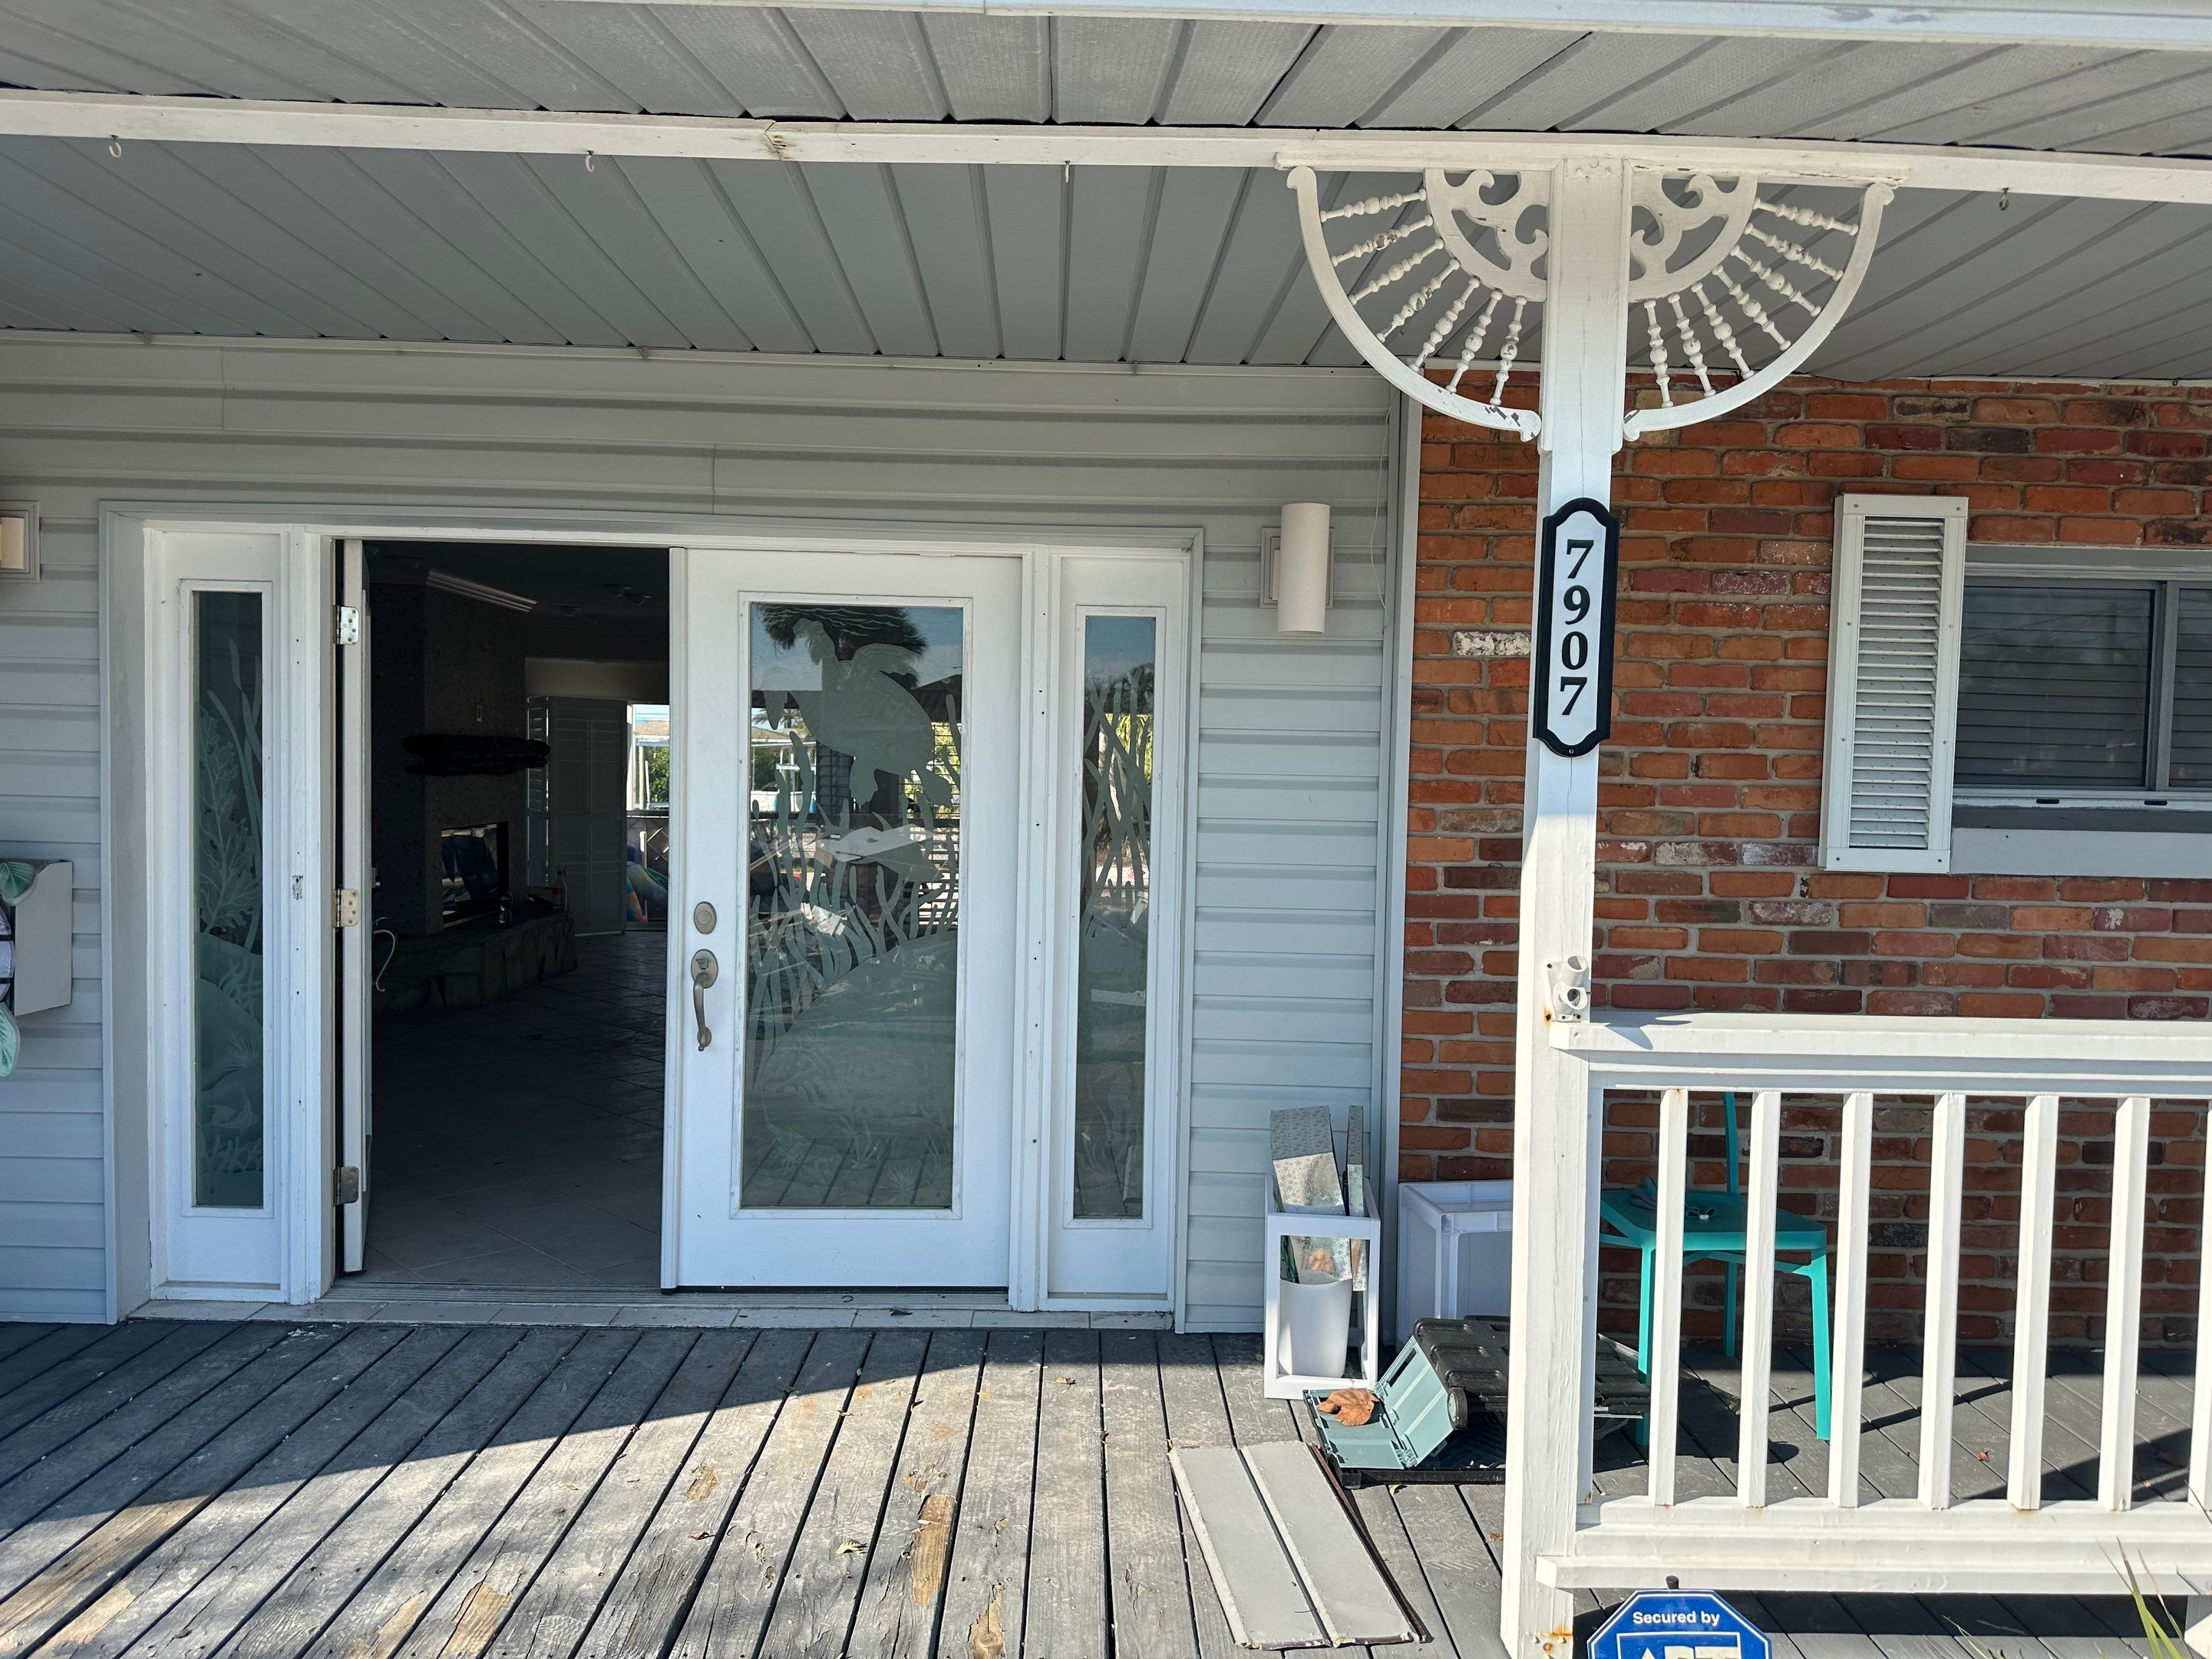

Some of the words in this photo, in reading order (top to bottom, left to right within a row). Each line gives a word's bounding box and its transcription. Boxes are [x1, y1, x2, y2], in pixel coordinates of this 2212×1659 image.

[1560, 539, 1594, 716] 7907
[1633, 1611, 1696, 1624] Secured
[1701, 1611, 1720, 1626] by
